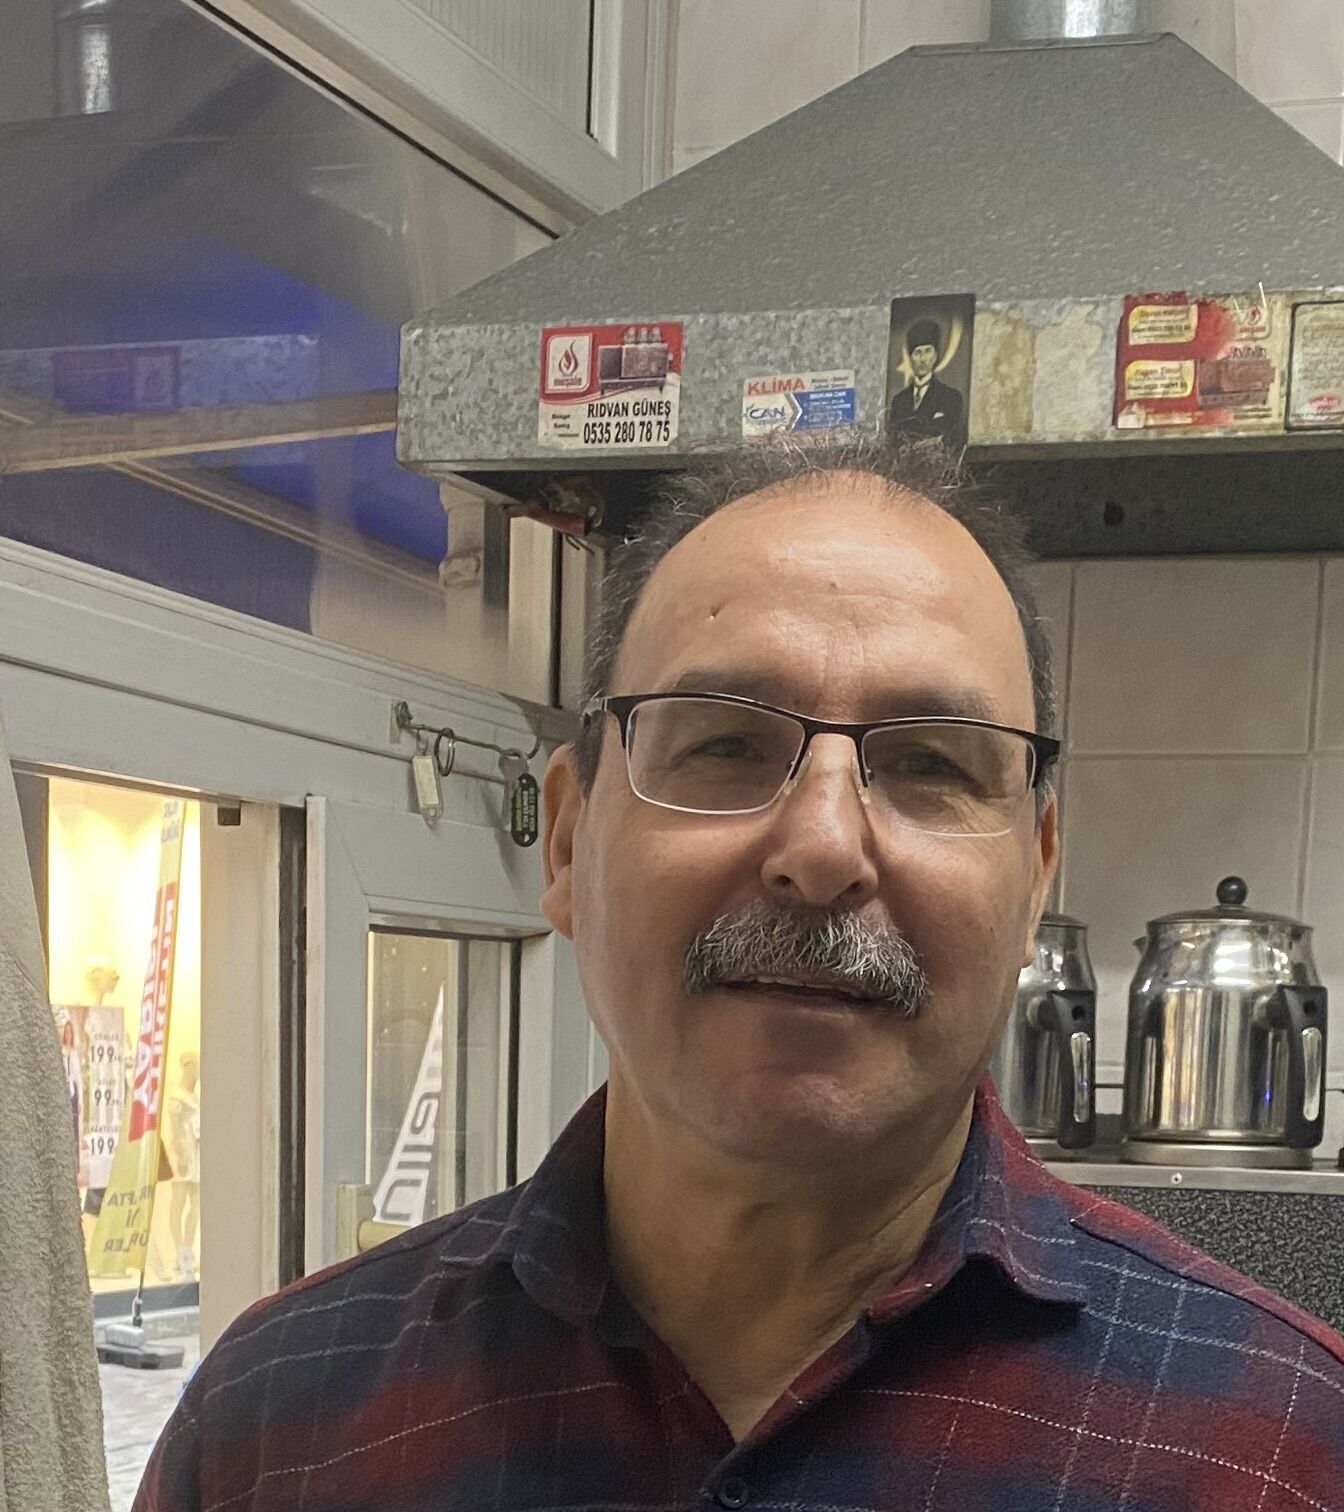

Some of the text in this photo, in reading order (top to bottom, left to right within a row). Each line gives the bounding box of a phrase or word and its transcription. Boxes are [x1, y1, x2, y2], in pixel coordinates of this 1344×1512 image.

[748, 377, 805, 395] KLİMA
[587, 398, 671, 419] RIDVAN GÜNEŞ
[583, 420, 670, 444] 0535 280 78 75
